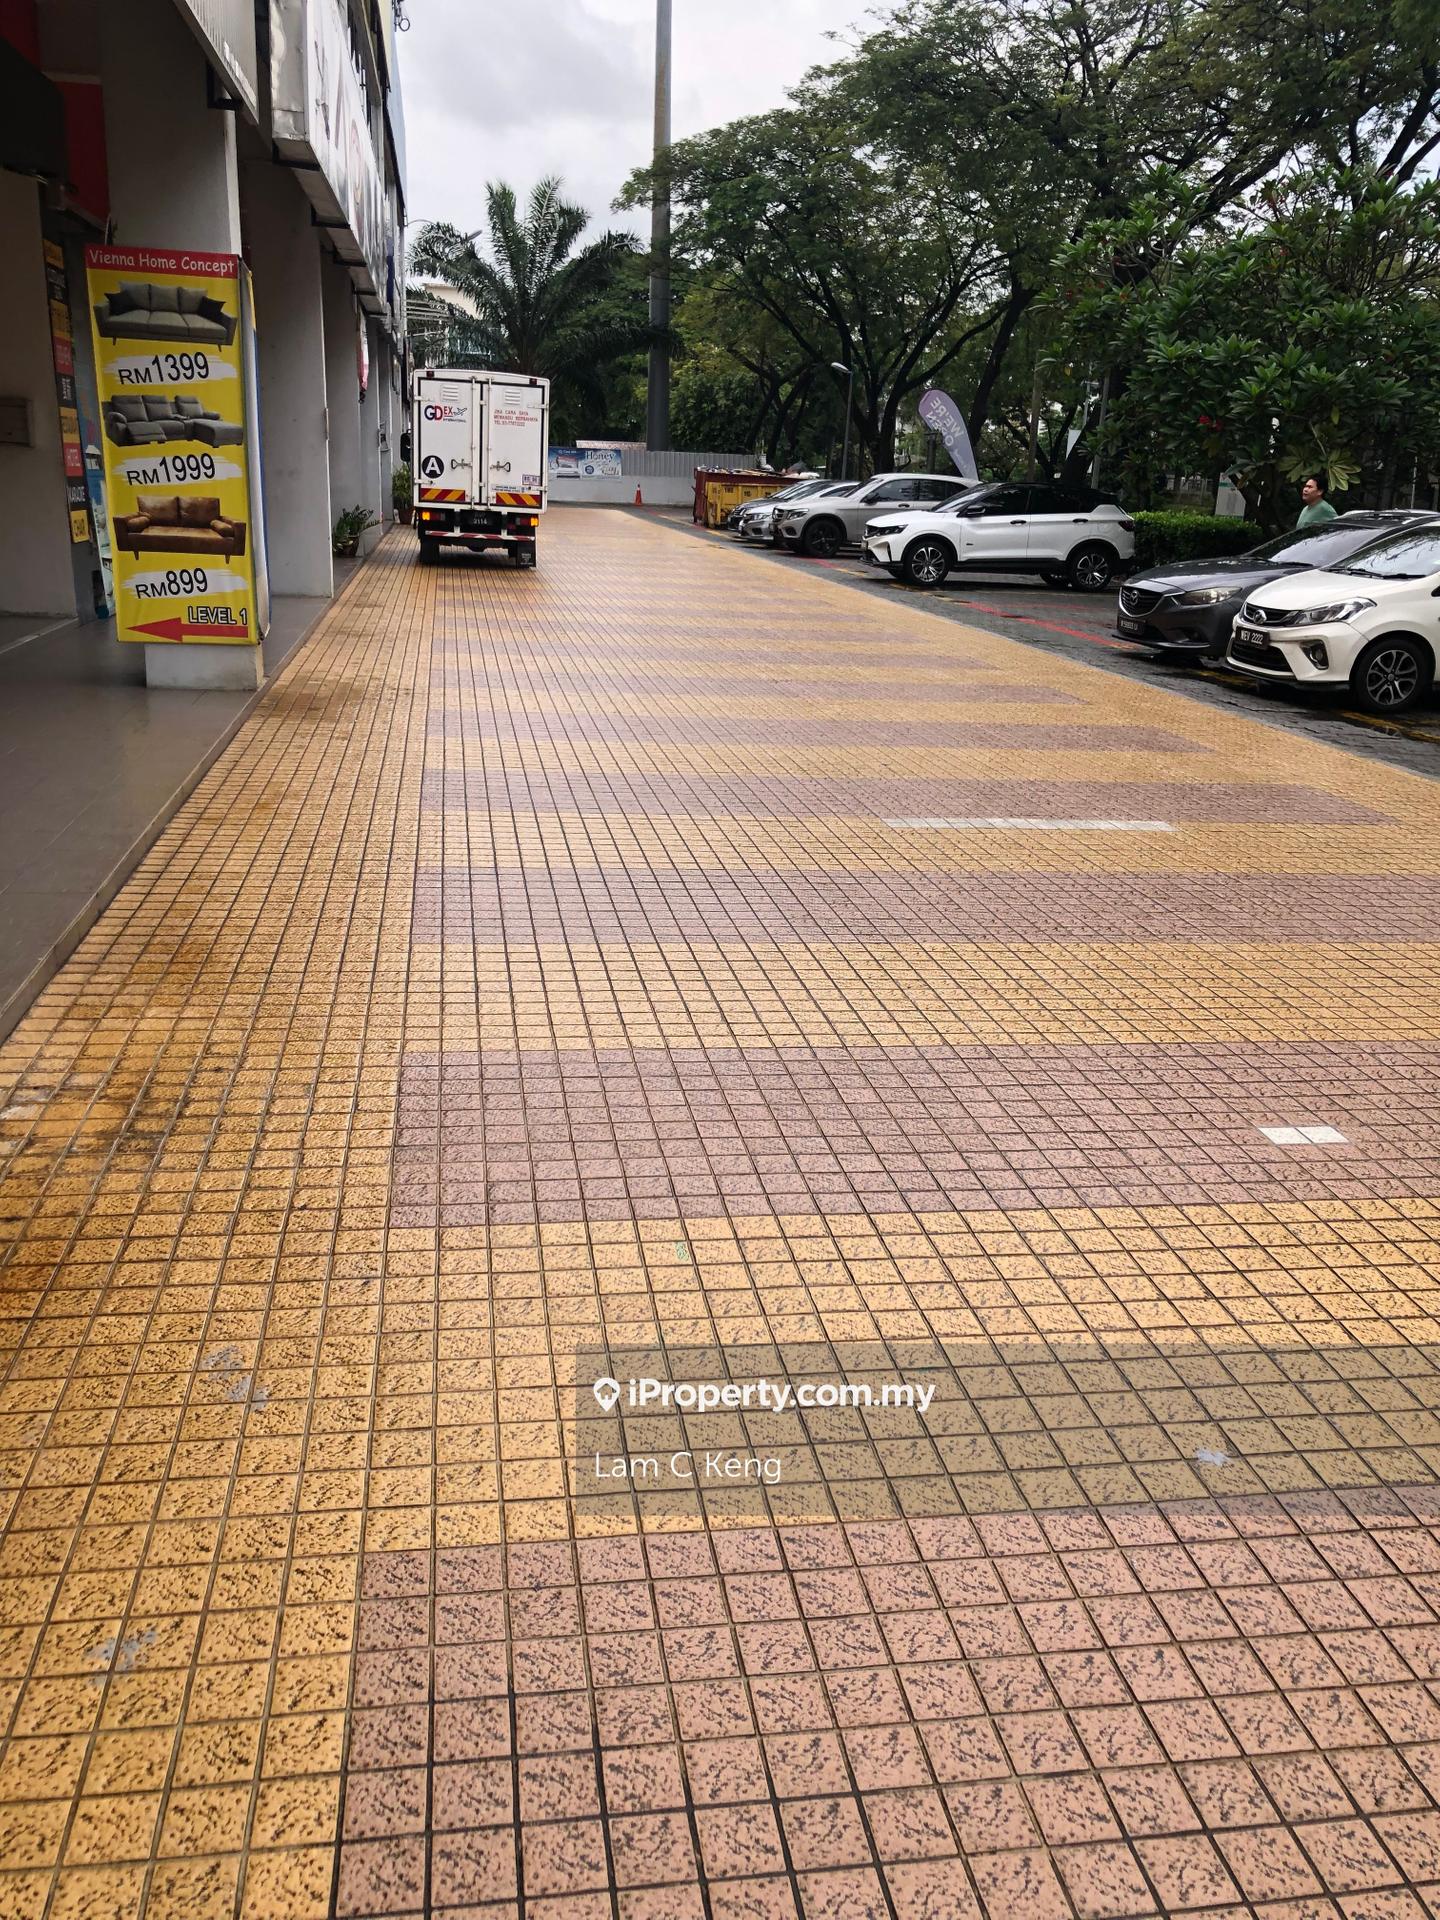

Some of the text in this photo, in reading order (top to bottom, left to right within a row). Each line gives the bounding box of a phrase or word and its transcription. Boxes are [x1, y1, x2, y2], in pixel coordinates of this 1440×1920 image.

[89, 249, 236, 276] Vienna Home Concept
[118, 351, 210, 385] RM1399
[126, 453, 216, 485] RM1999
[425, 458, 441, 475] A
[136, 568, 209, 599] RM899
[188, 606, 248, 625] LEVEL 1
[1251, 633, 1264, 645] 2222
